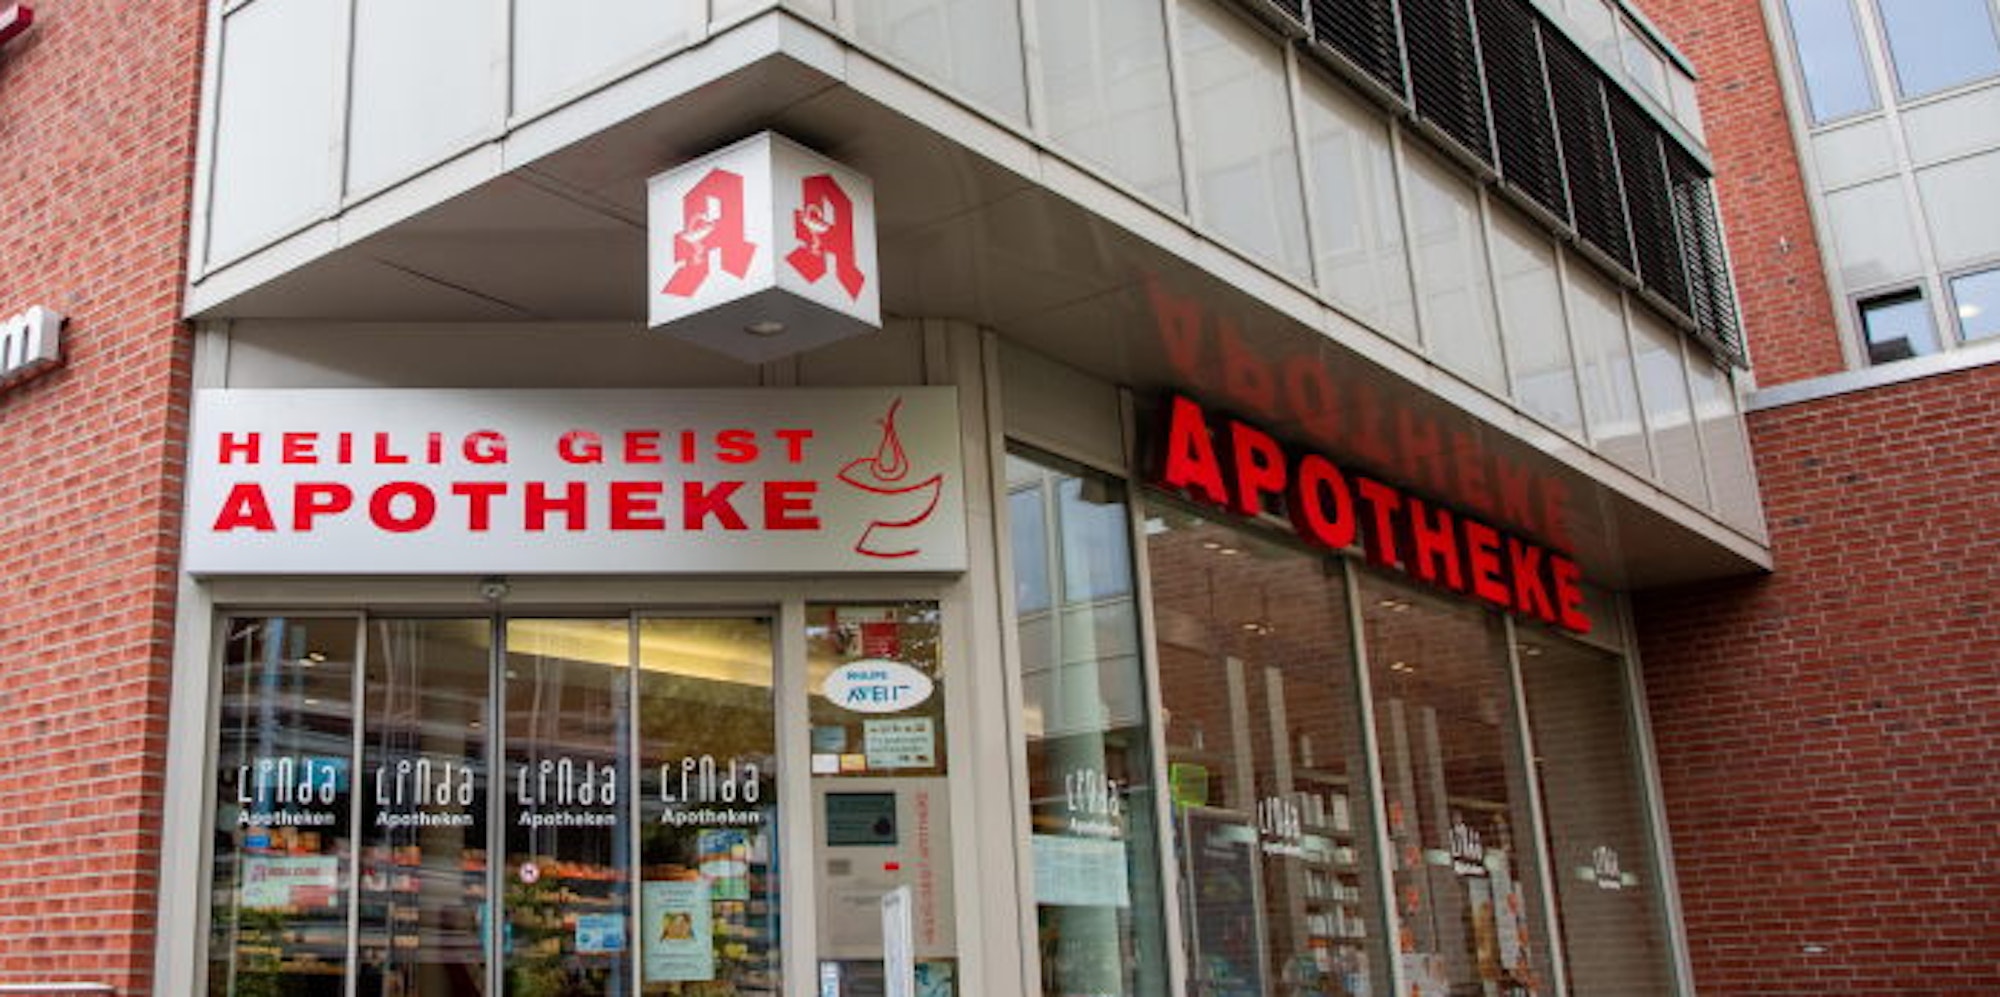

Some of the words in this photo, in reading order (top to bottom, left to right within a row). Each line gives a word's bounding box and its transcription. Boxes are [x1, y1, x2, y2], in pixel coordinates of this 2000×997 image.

[217, 431, 509, 465] HEILIG
[556, 428, 815, 465] GEIST
[212, 479, 821, 533] APOTHEKE
[1157, 396, 1592, 634] APOTHEKE
[237, 809, 336, 826] Apotheken
[376, 811, 474, 827] Apotheken
[518, 811, 617, 828] Apotheken
[661, 807, 760, 825] Apotheken
